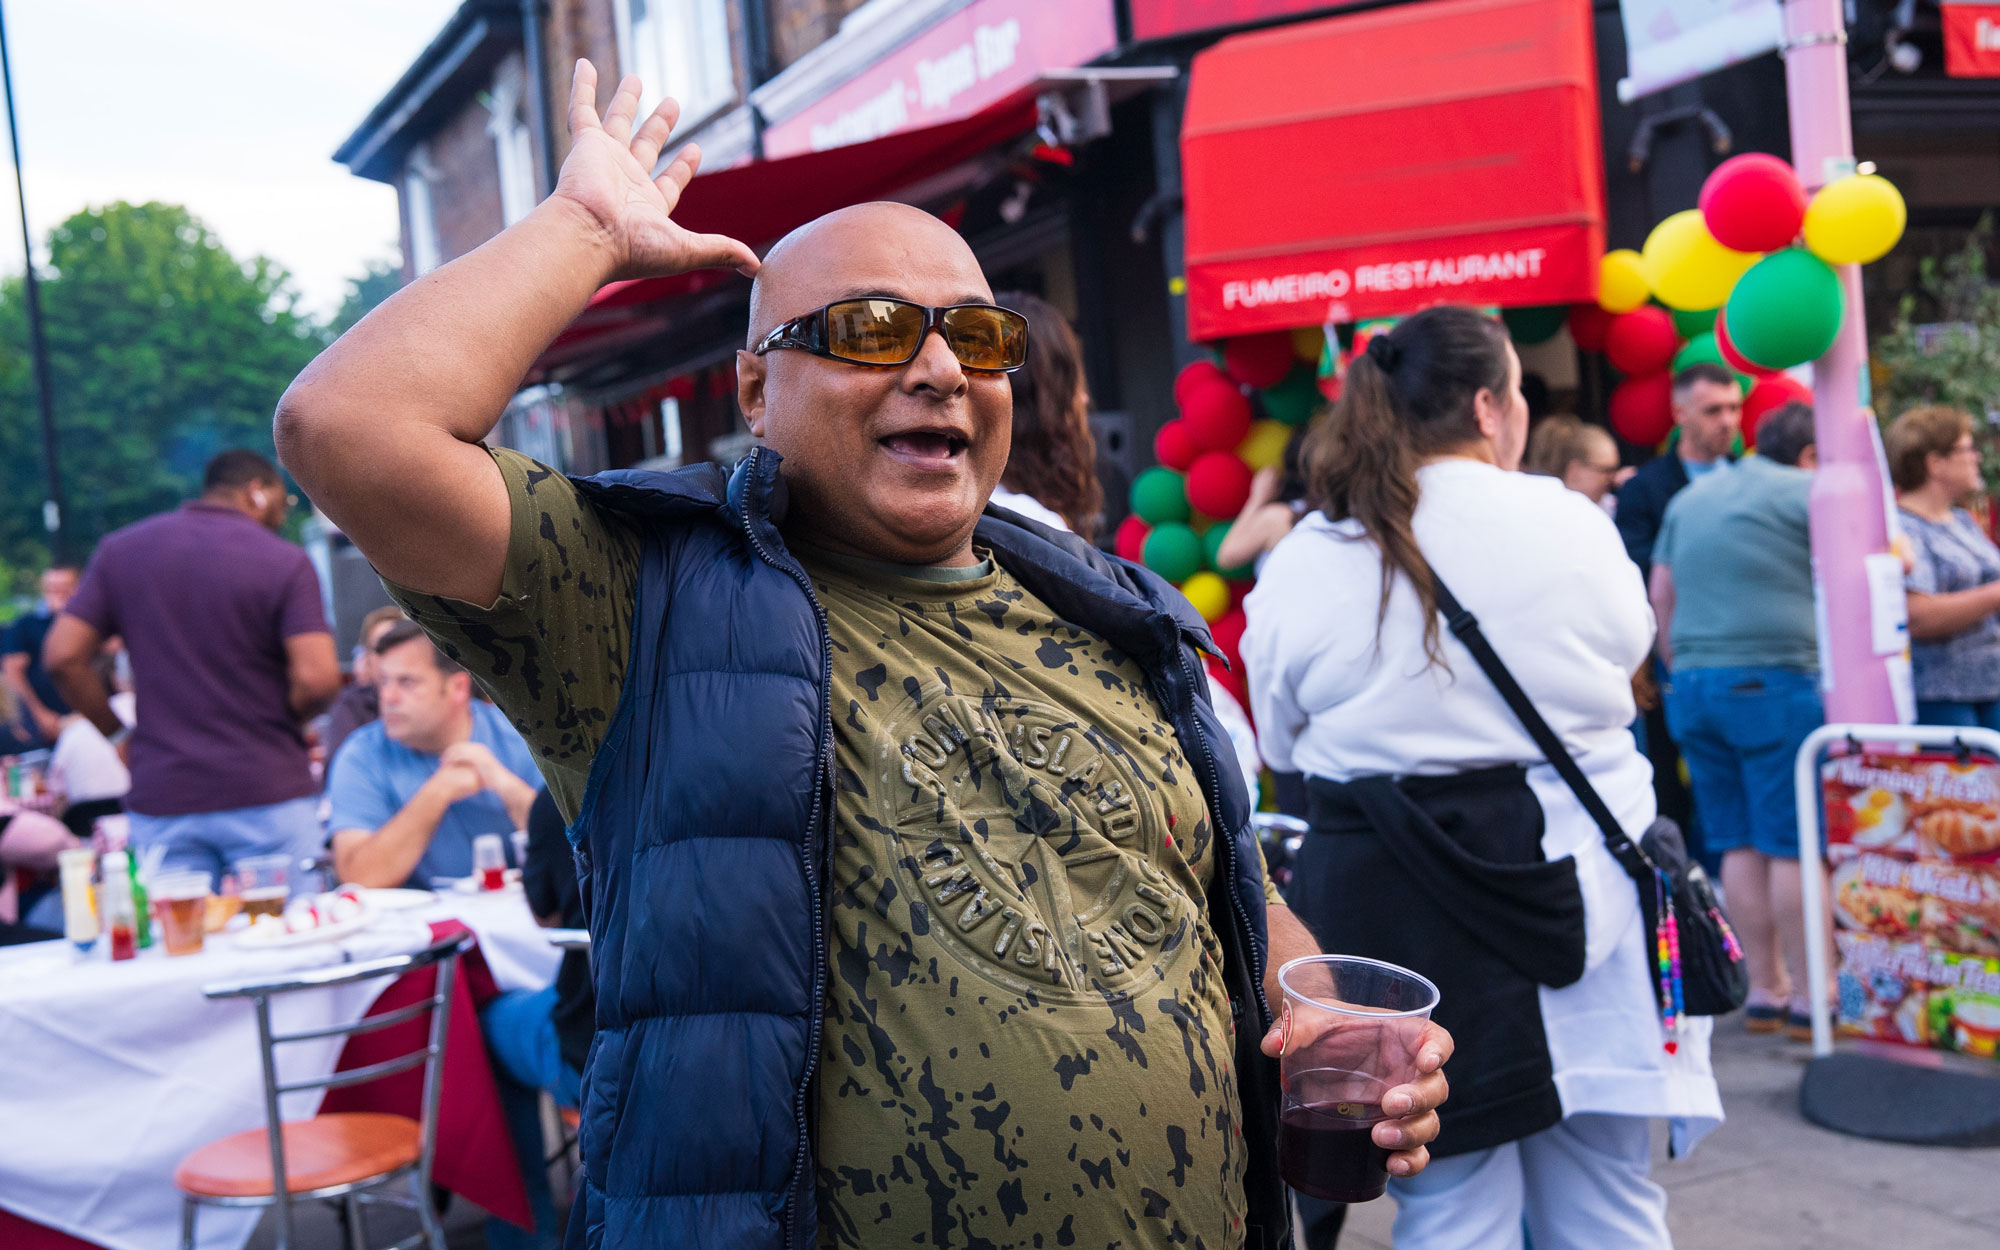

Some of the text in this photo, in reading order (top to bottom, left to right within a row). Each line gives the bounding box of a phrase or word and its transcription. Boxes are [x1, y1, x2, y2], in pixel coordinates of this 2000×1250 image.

[1223, 248, 1546, 311] FUMEIRO RESTAURANT
[901, 699, 1140, 841] SON ISLAND
[914, 845, 1056, 972] ISLAND
